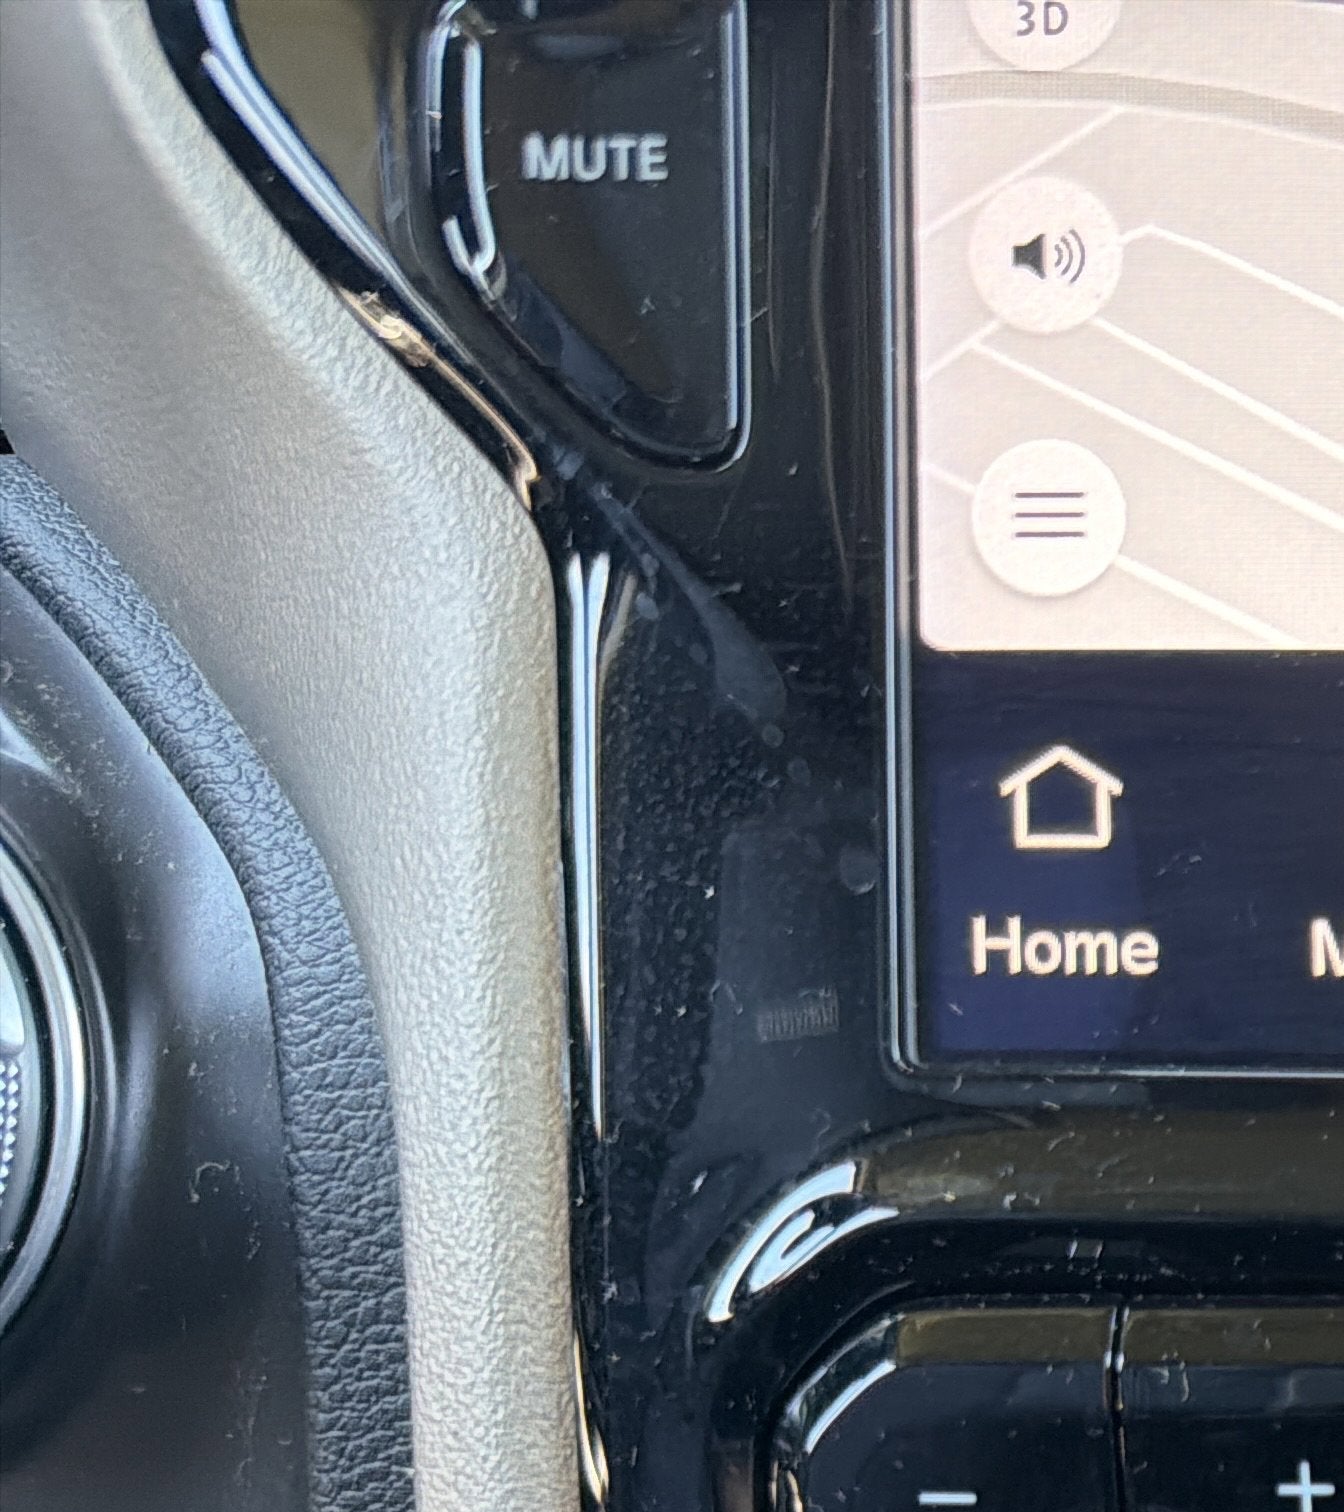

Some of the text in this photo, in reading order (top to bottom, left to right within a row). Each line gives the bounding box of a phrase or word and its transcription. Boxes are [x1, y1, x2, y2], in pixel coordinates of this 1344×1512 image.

[1016, 0, 1069, 37] 3D
[522, 132, 669, 181] MUTE
[972, 914, 1159, 976] Home
